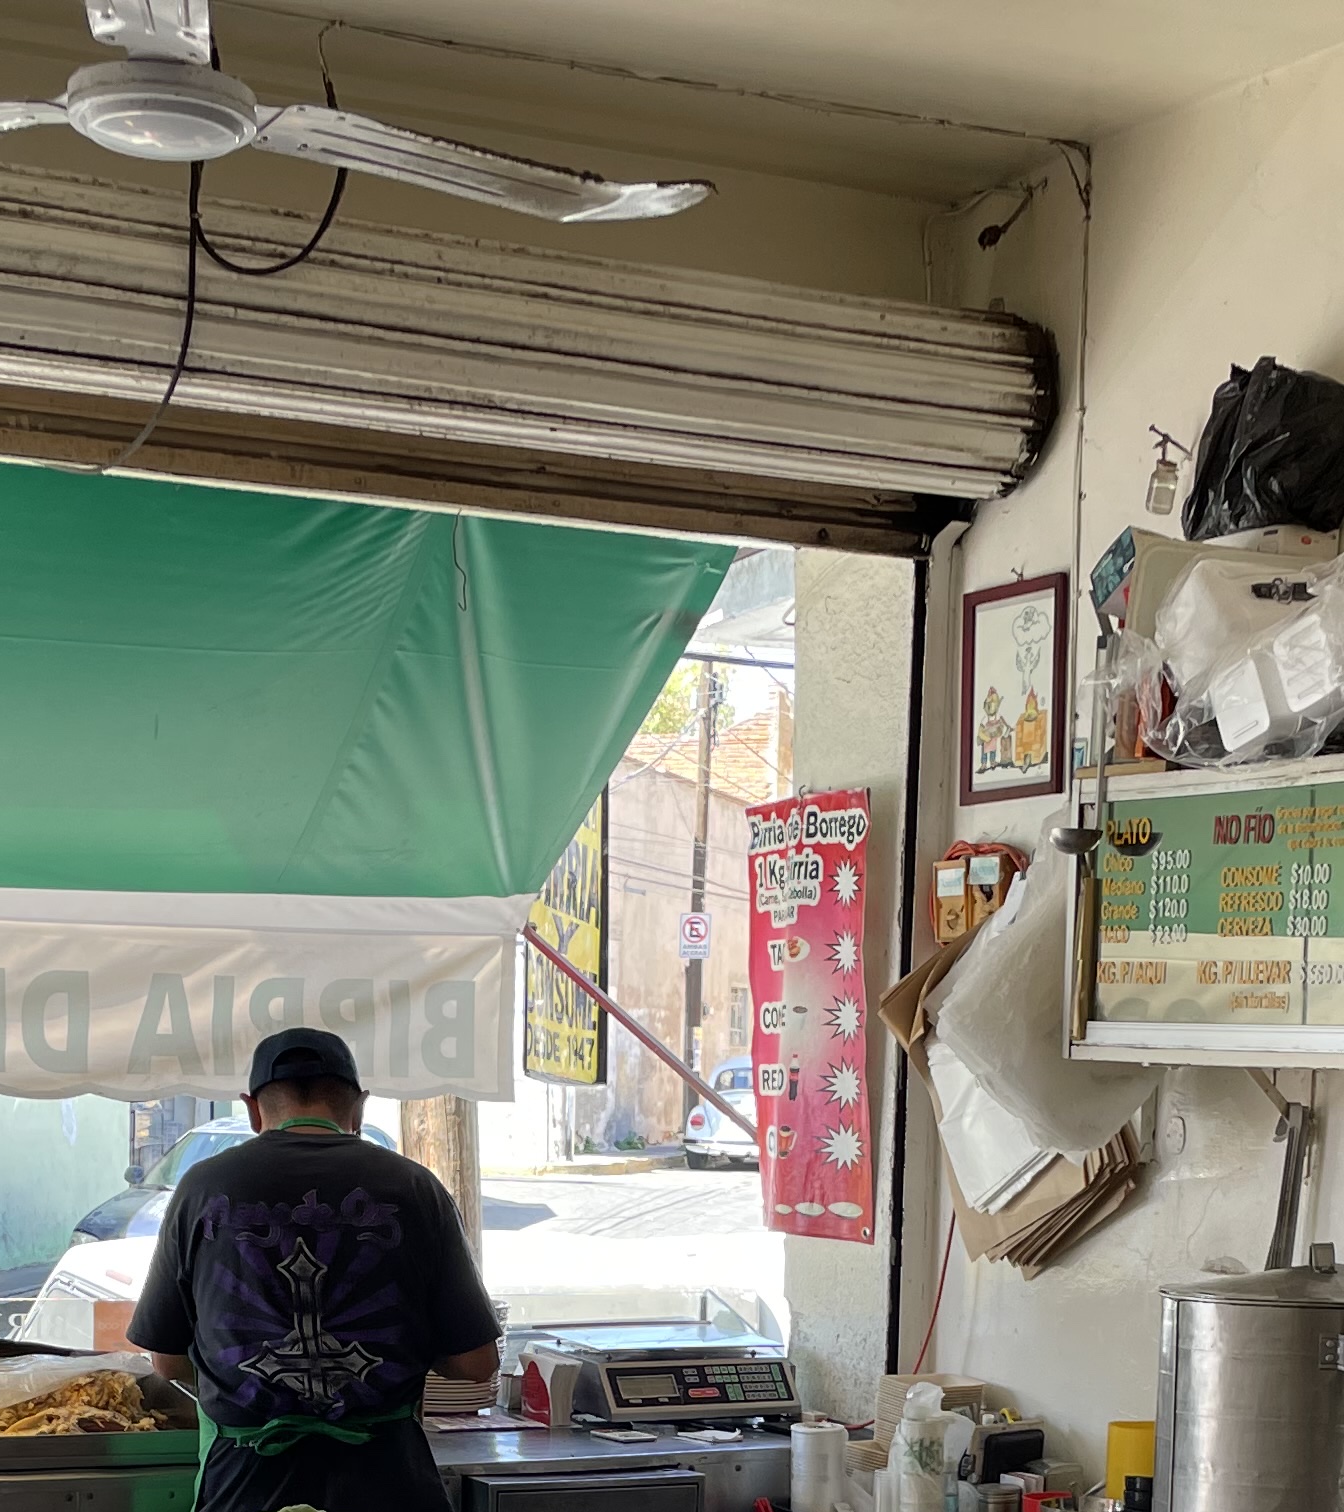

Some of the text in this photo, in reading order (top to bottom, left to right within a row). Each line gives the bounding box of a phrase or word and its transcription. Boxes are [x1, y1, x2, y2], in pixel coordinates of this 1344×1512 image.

[805, 811, 867, 844] Borrego
[1107, 817, 1152, 846] PLATO
[1213, 815, 1241, 845] NO
[1151, 849, 1191, 871] $95.00
[758, 862, 763, 888] 1
[769, 860, 785, 890] Kg
[1150, 874, 1189, 895] $110.0
[1290, 862, 1331, 885] $10.00
[1148, 897, 1188, 919] $120.0
[1219, 889, 1329, 912] REFRESCO $18.00
[1100, 924, 1130, 944] TACO
[1217, 915, 1328, 937] CERVEZA $30.00
